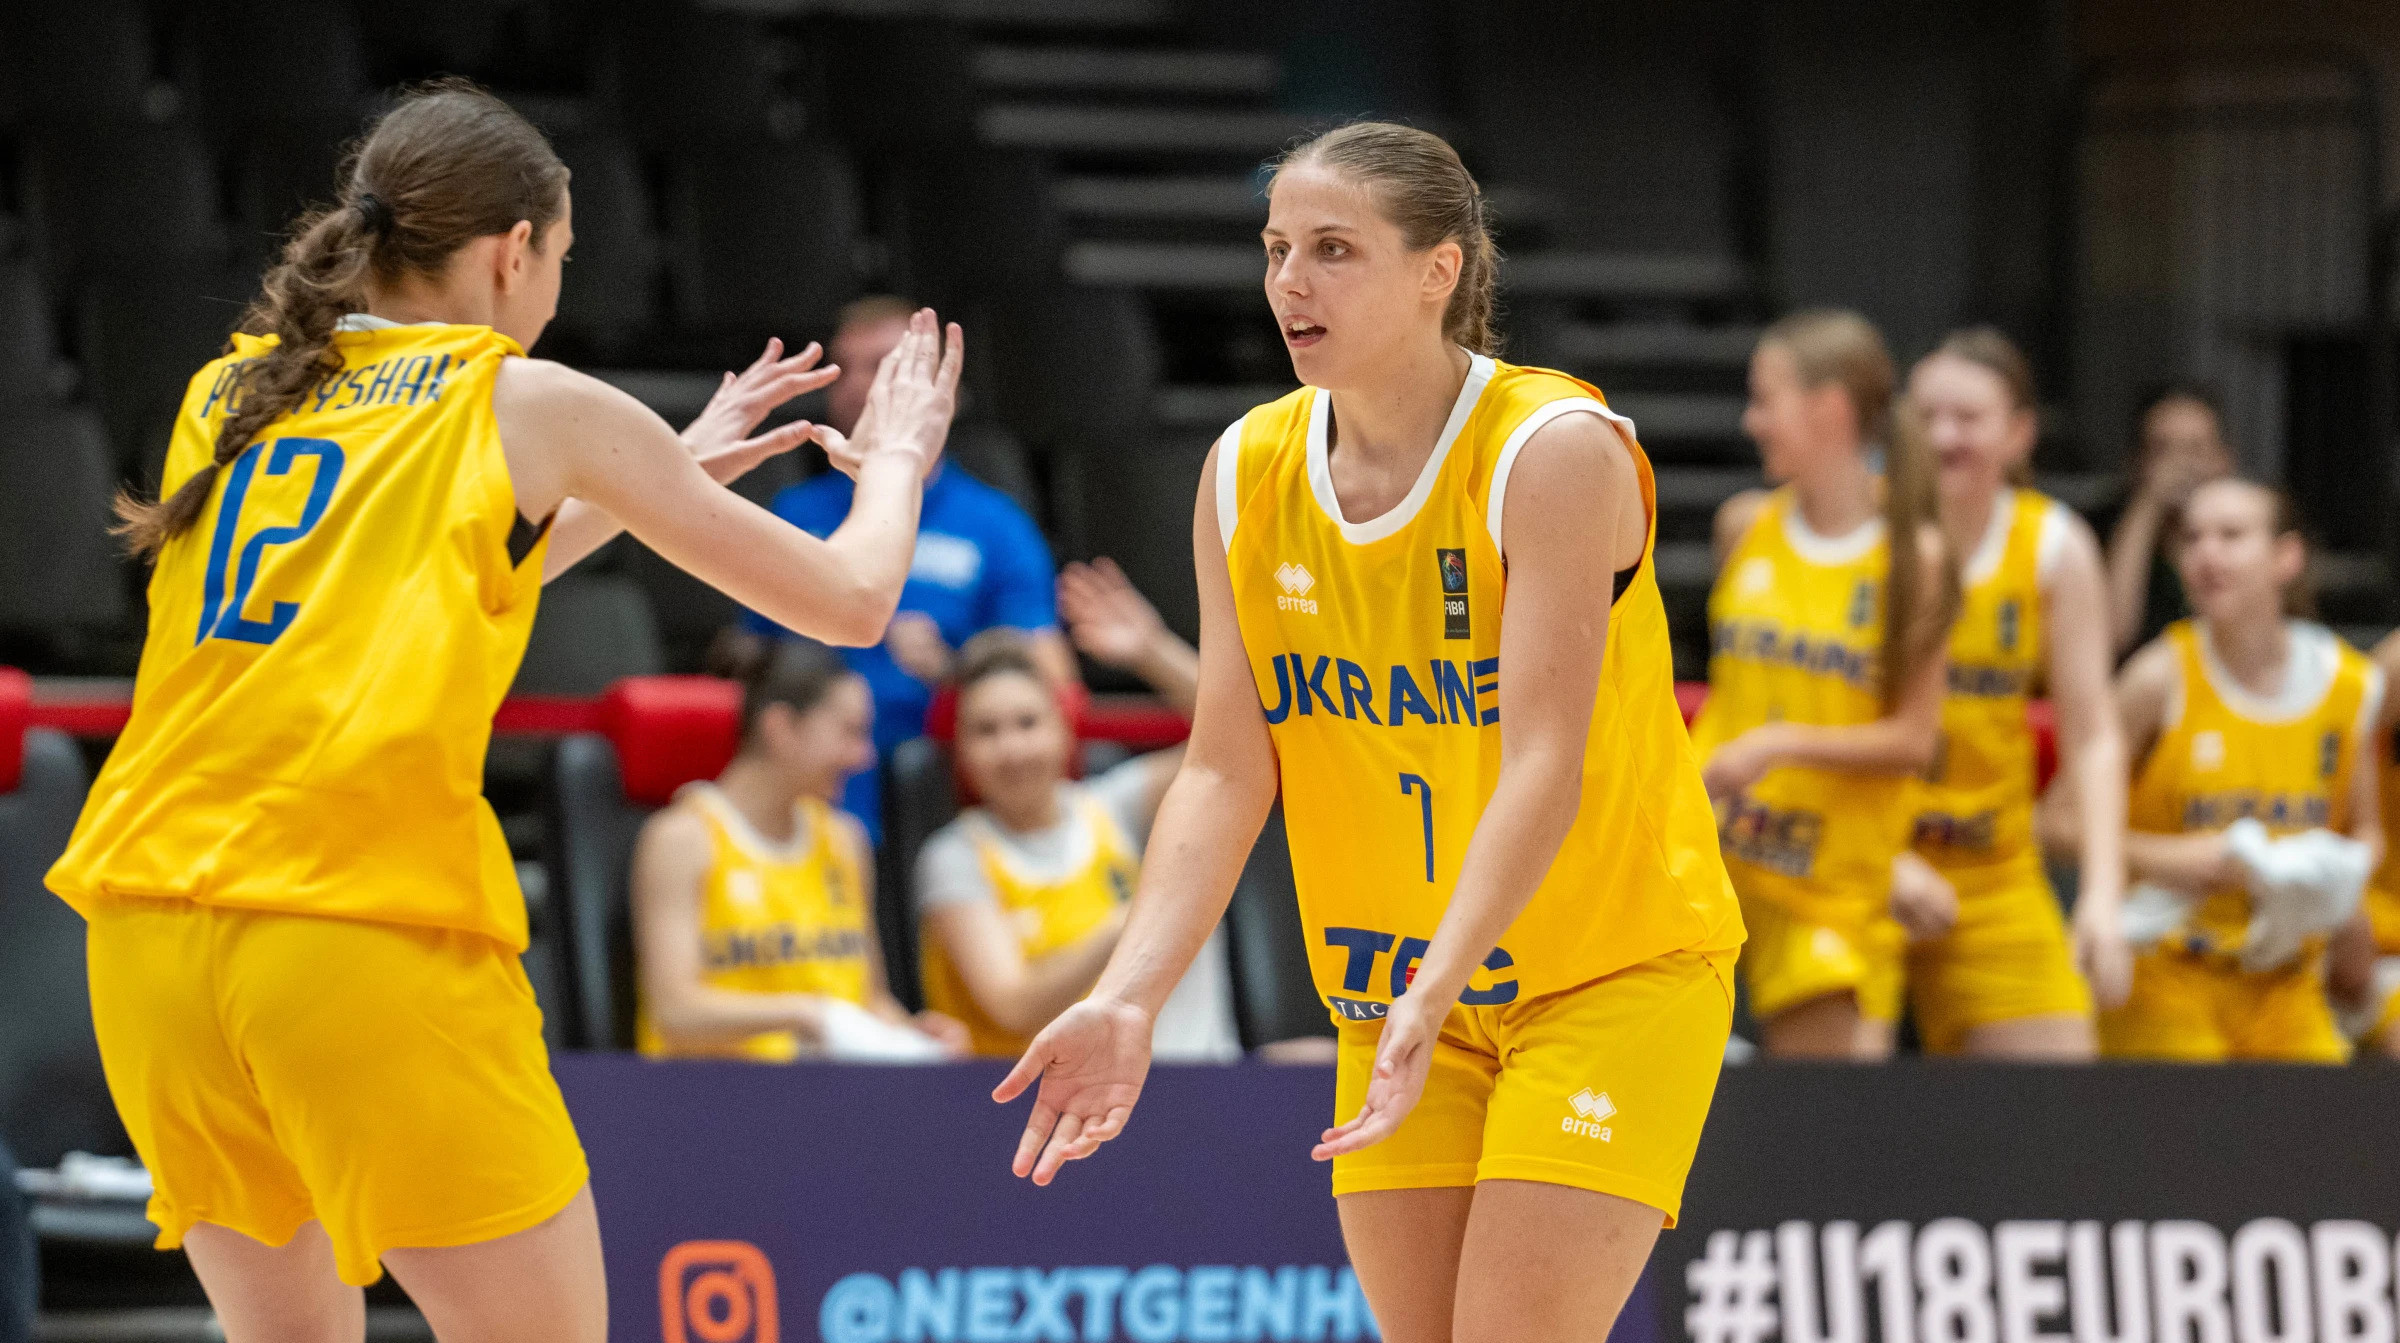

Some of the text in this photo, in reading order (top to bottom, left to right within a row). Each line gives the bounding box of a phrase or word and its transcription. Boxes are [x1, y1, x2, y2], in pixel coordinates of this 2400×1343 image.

[195, 436, 345, 647] 12
[1444, 600, 1466, 616] FIBA
[1264, 652, 1500, 727] UKRAINE
[1398, 771, 1435, 884] 7
[1336, 1001, 1390, 1018] TAC
[1561, 1116, 1613, 1144] errea
[1685, 1217, 2400, 1343] #U18EUROB
